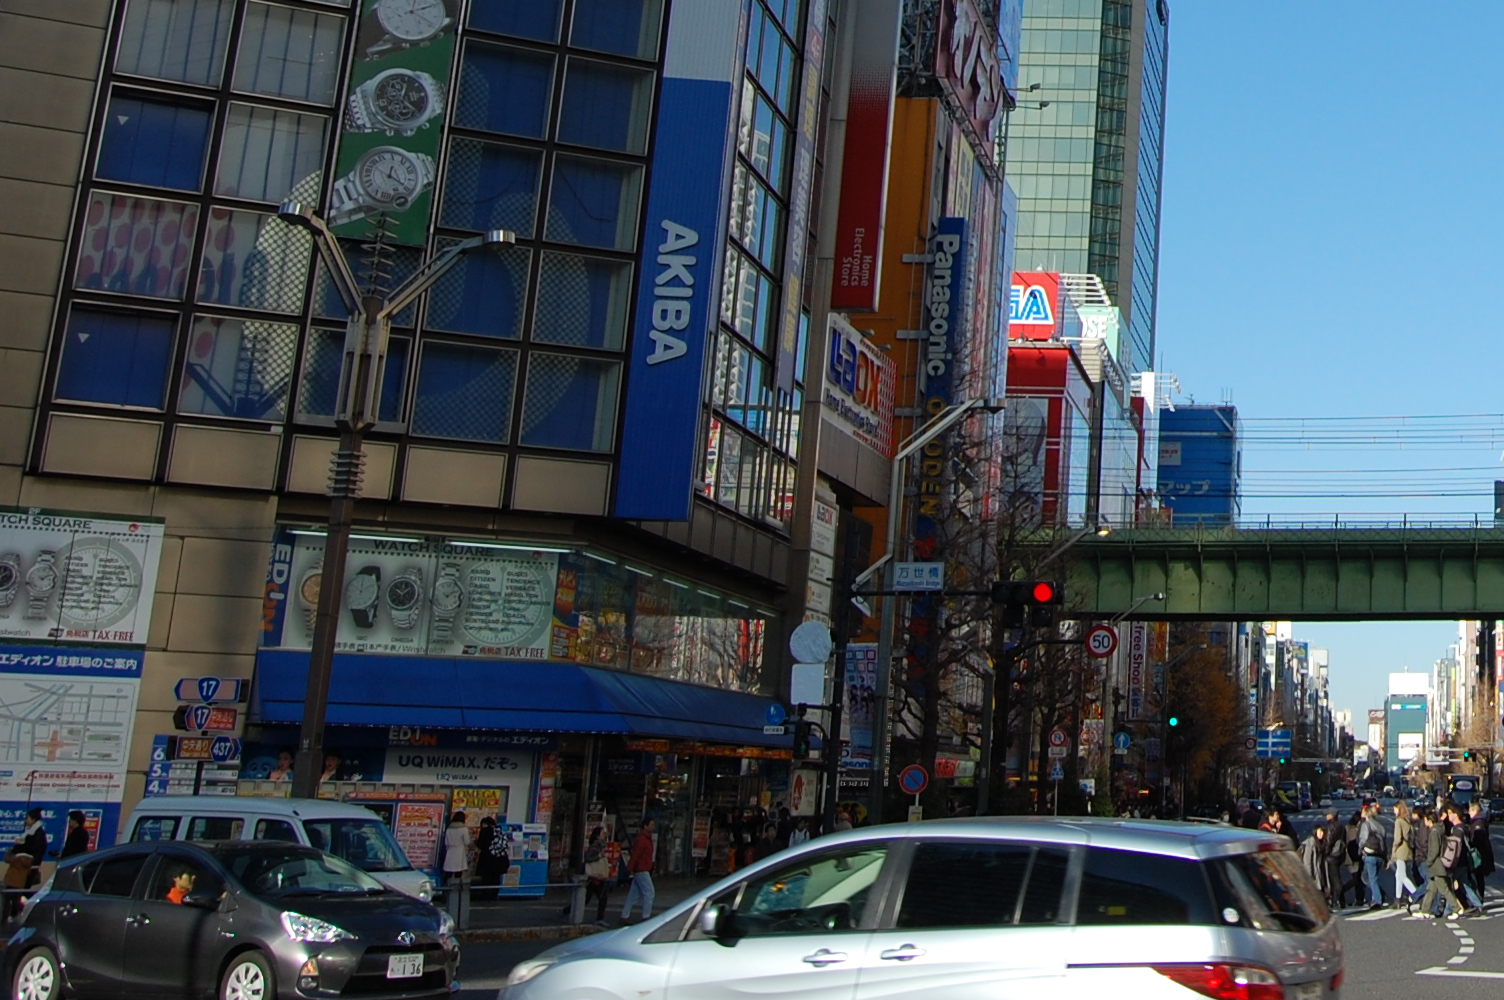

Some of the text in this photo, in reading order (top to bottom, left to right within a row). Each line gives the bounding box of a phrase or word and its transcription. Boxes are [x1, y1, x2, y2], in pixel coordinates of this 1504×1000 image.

[851, 227, 865, 286] Electronics
[841, 256, 852, 287] Store
[861, 255, 873, 287] Home
[646, 219, 699, 365] AKIBA
[927, 234, 960, 377] Panasonic
[920, 396, 947, 515] OODEN
[32, 516, 93, 530] SQUARE
[374, 540, 431, 553] WATCH
[898, 565, 940, 579] 万世橋
[1092, 634, 1111, 650] 50
[0, 654, 138, 670] エディオン 駐車場のご案内
[202, 680, 217, 696] 17
[197, 708, 209, 724] 17
[512, 735, 549, 745] エディオン
[213, 742, 231, 756] 437
[398, 754, 425, 768] UQ
[457, 788, 499, 799] OMEGA
